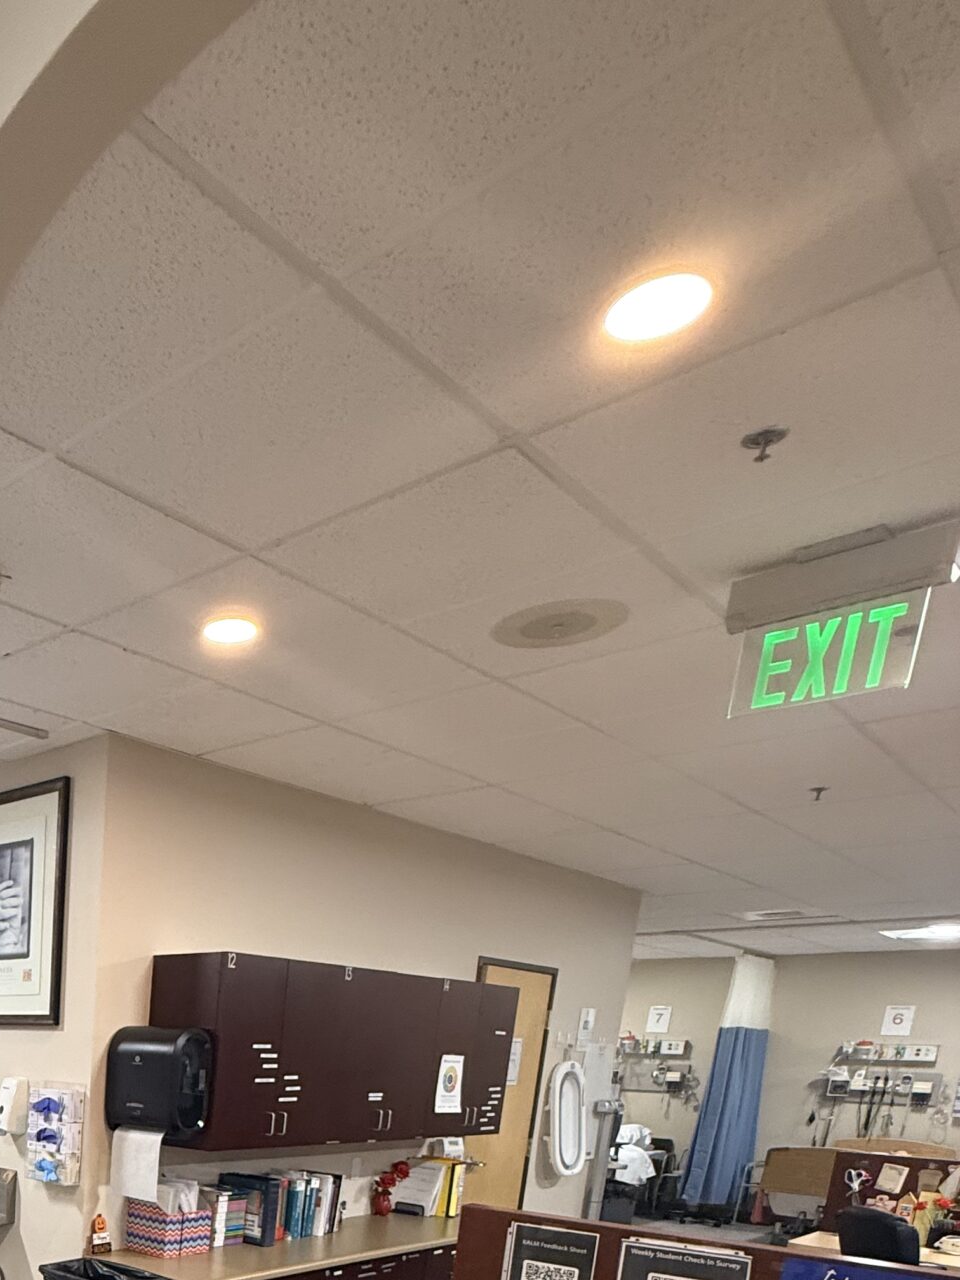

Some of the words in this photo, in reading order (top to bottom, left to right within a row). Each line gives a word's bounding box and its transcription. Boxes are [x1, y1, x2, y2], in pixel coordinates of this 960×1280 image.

[751, 602, 909, 709] EXIT
[227, 953, 237, 969] 12
[344, 966, 353, 981] 13
[655, 1012, 664, 1023] 7
[892, 1012, 904, 1025] 6
[540, 1242, 568, 1251] Feedback
[569, 1246, 587, 1255] Sheet
[631, 1248, 655, 1259] Weekly
[656, 1251, 682, 1261] Student
[716, 1259, 741, 1271] Survey
